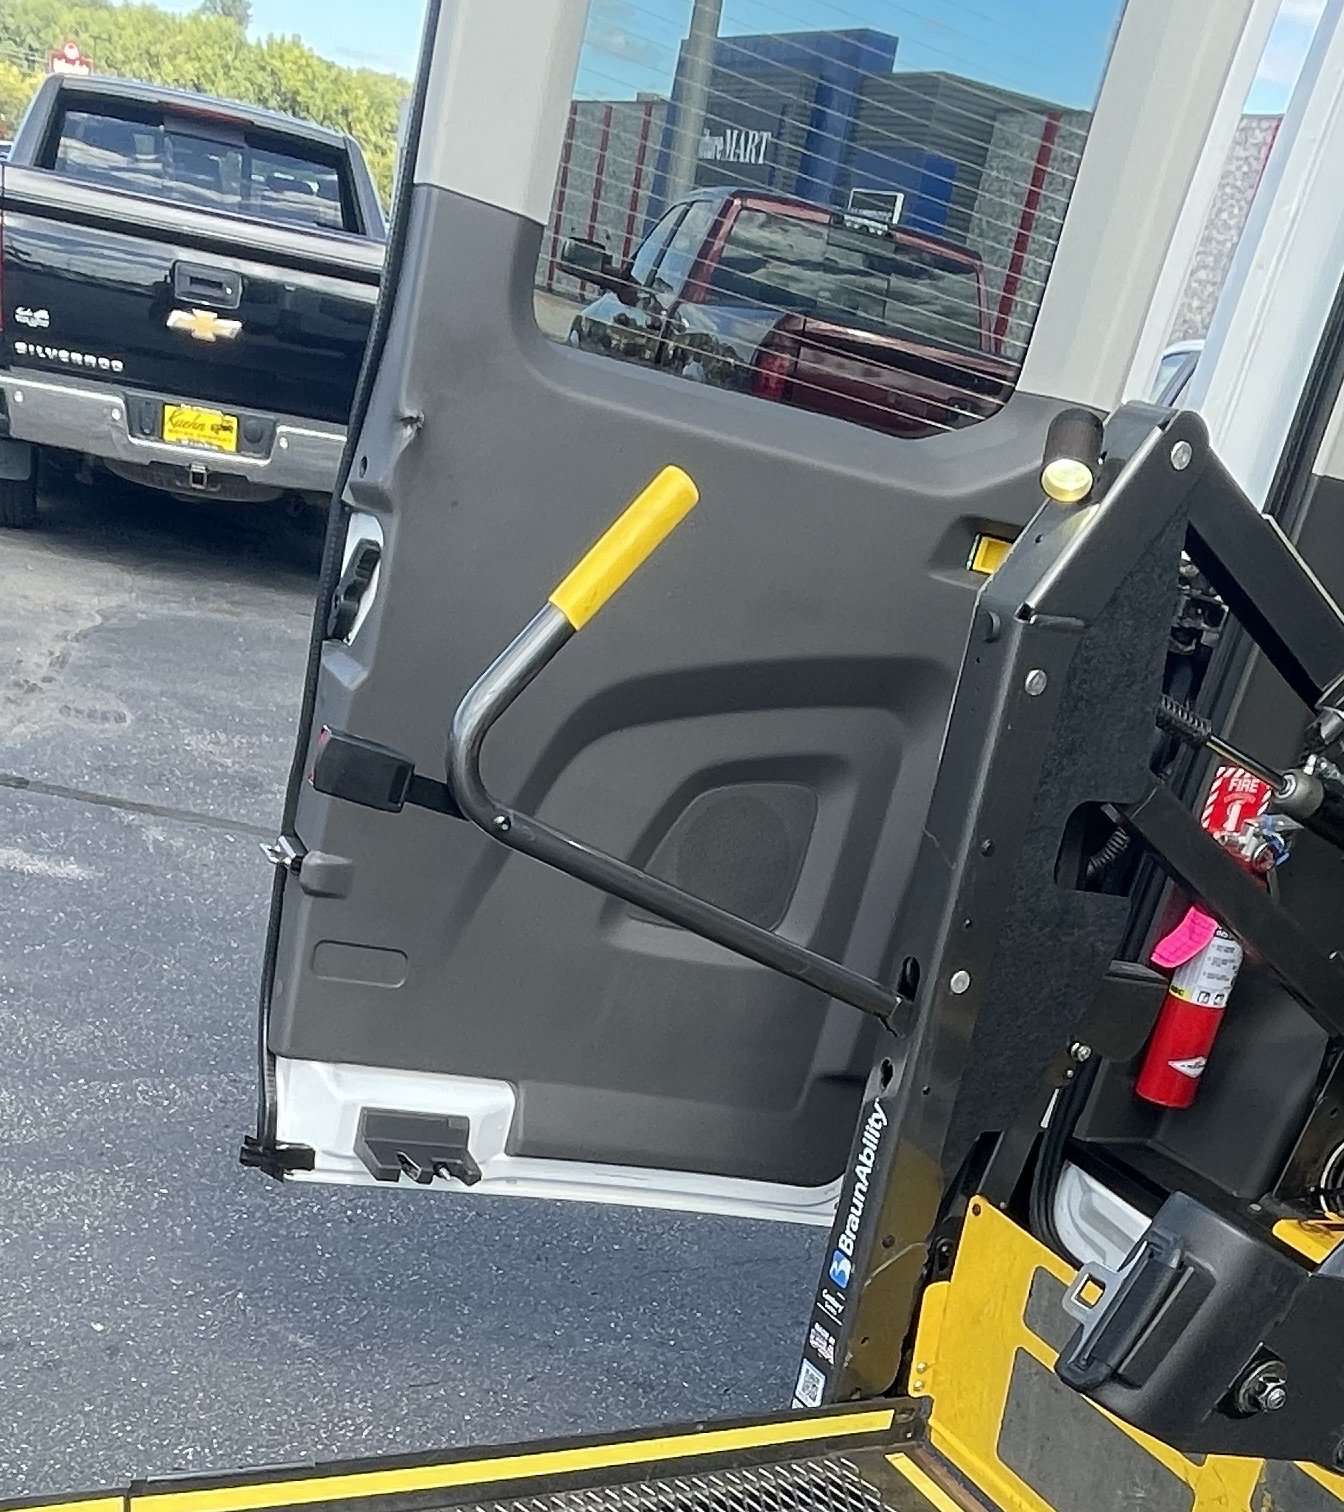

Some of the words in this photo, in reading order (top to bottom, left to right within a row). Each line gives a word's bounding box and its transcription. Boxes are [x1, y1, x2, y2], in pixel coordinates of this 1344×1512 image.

[14, 341, 125, 372] SILVERADO
[1228, 776, 1262, 794] FIRE
[838, 1097, 888, 1257] BraunAbility
